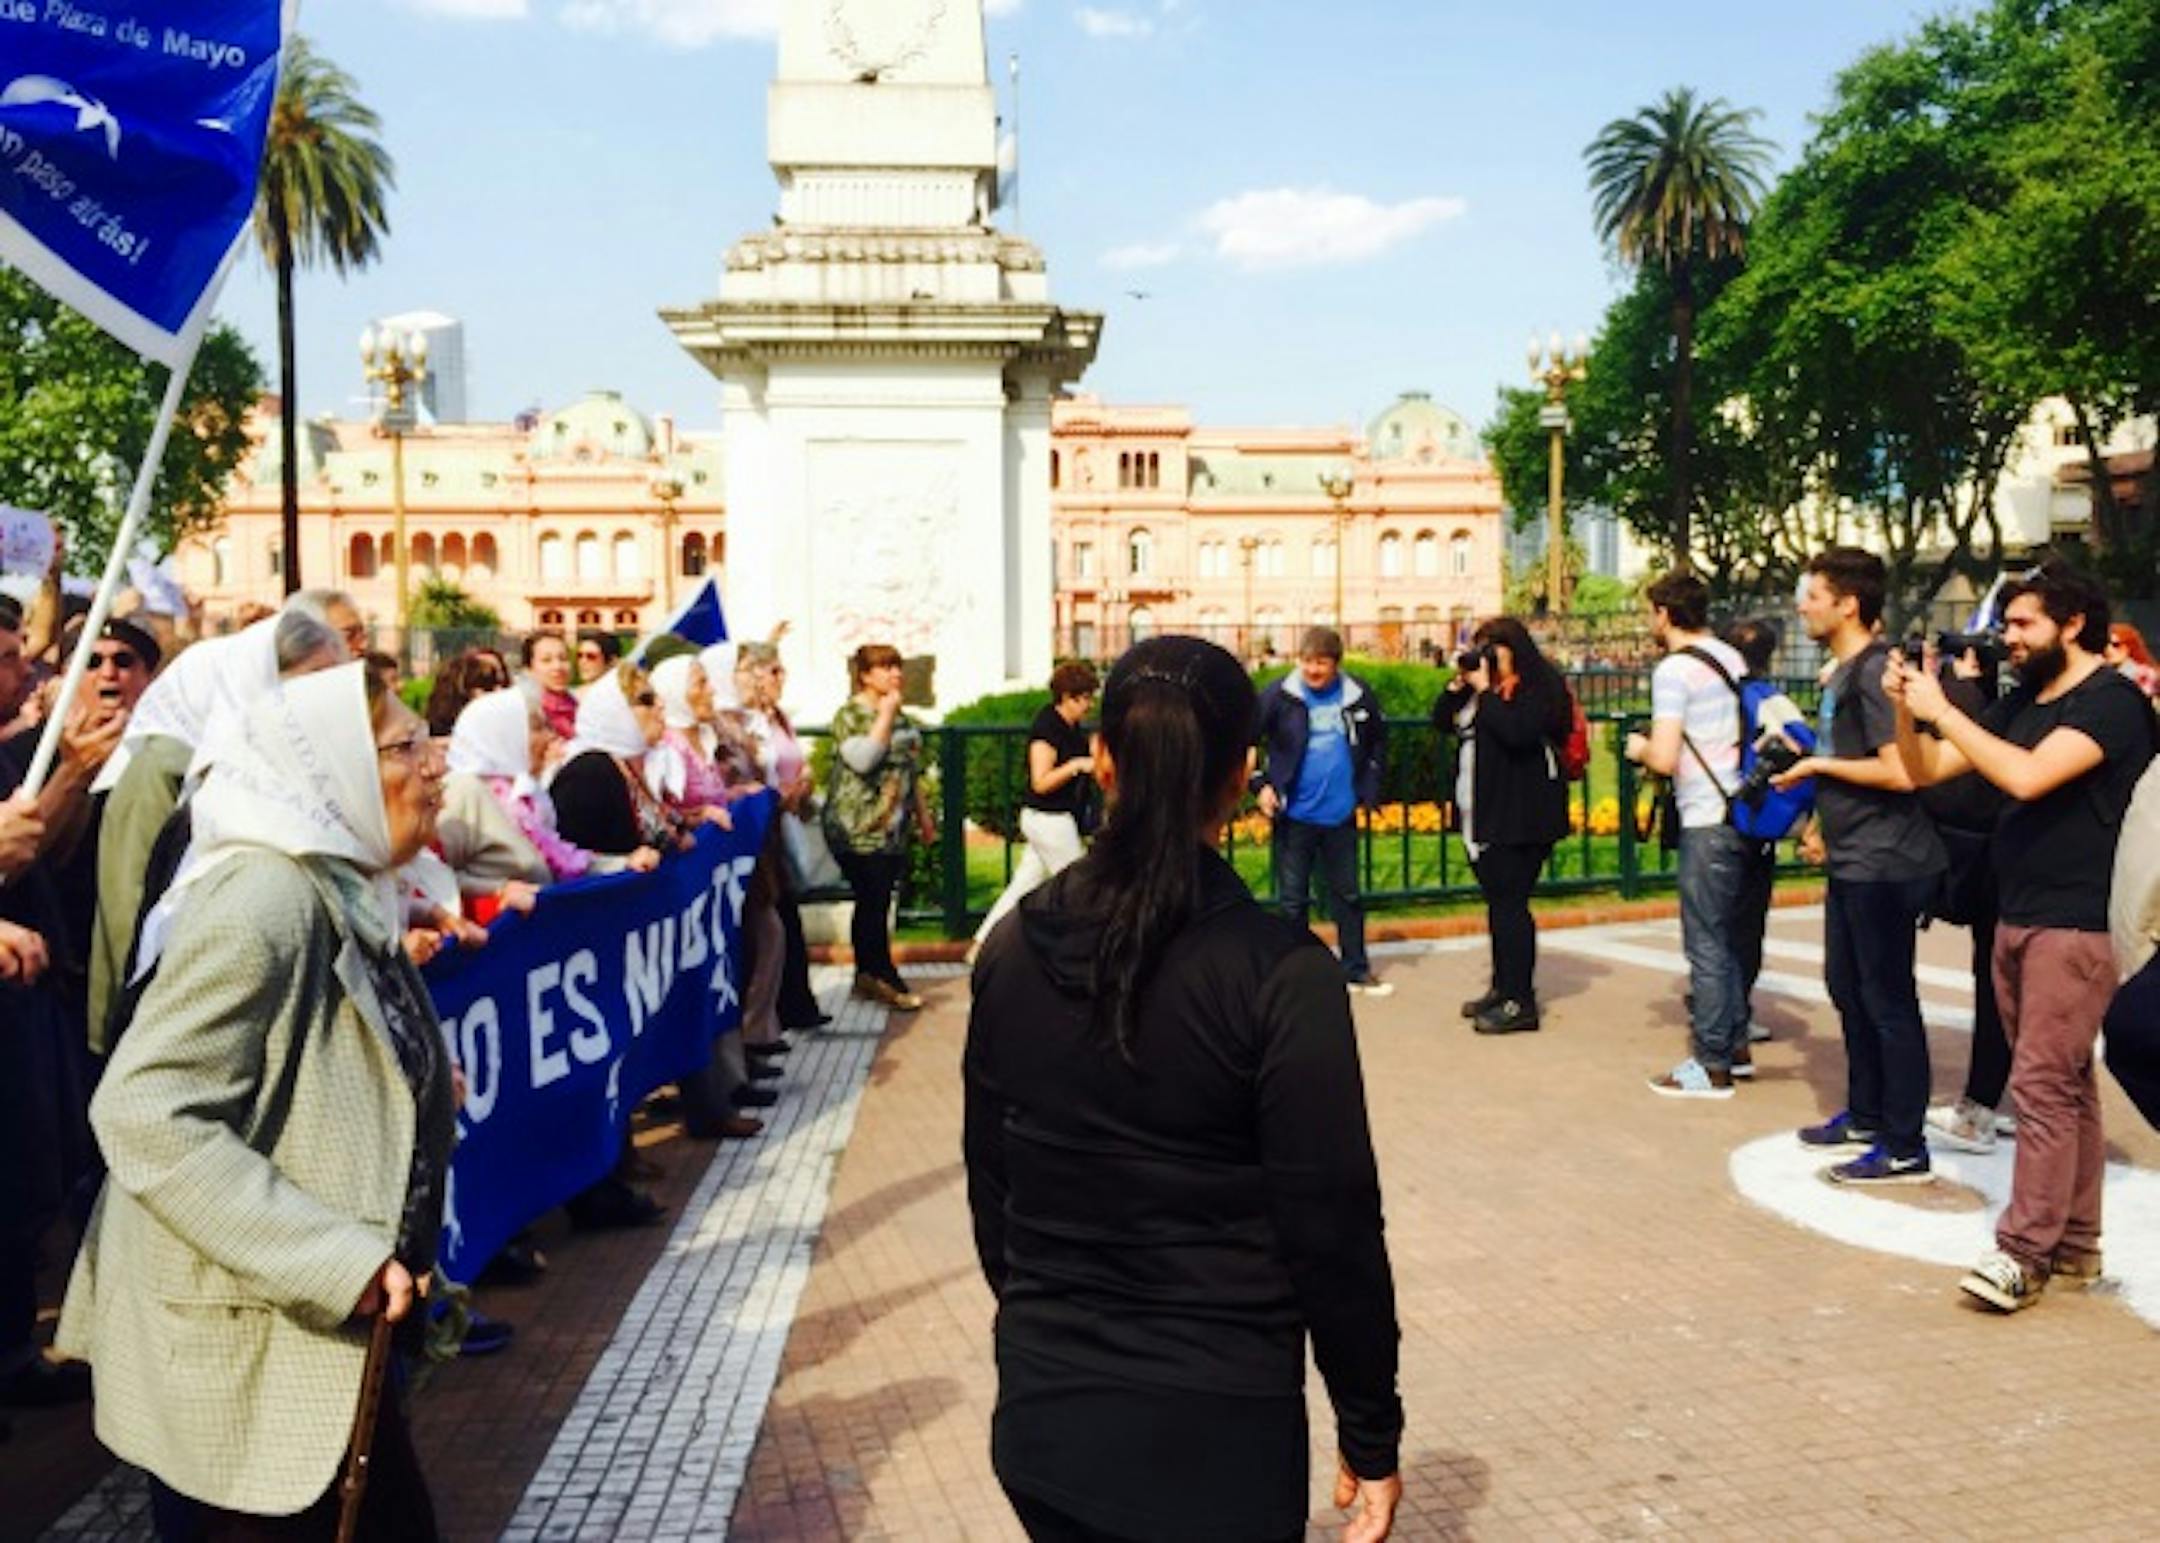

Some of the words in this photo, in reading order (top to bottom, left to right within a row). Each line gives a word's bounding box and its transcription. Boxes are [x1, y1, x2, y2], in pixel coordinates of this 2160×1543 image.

[0, 0, 36, 22] de
[42, 0, 107, 37] Plaza
[115, 18, 150, 49] de
[163, 27, 247, 69] Mayo
[13, 149, 77, 200] paso
[526, 948, 611, 1089] ES
